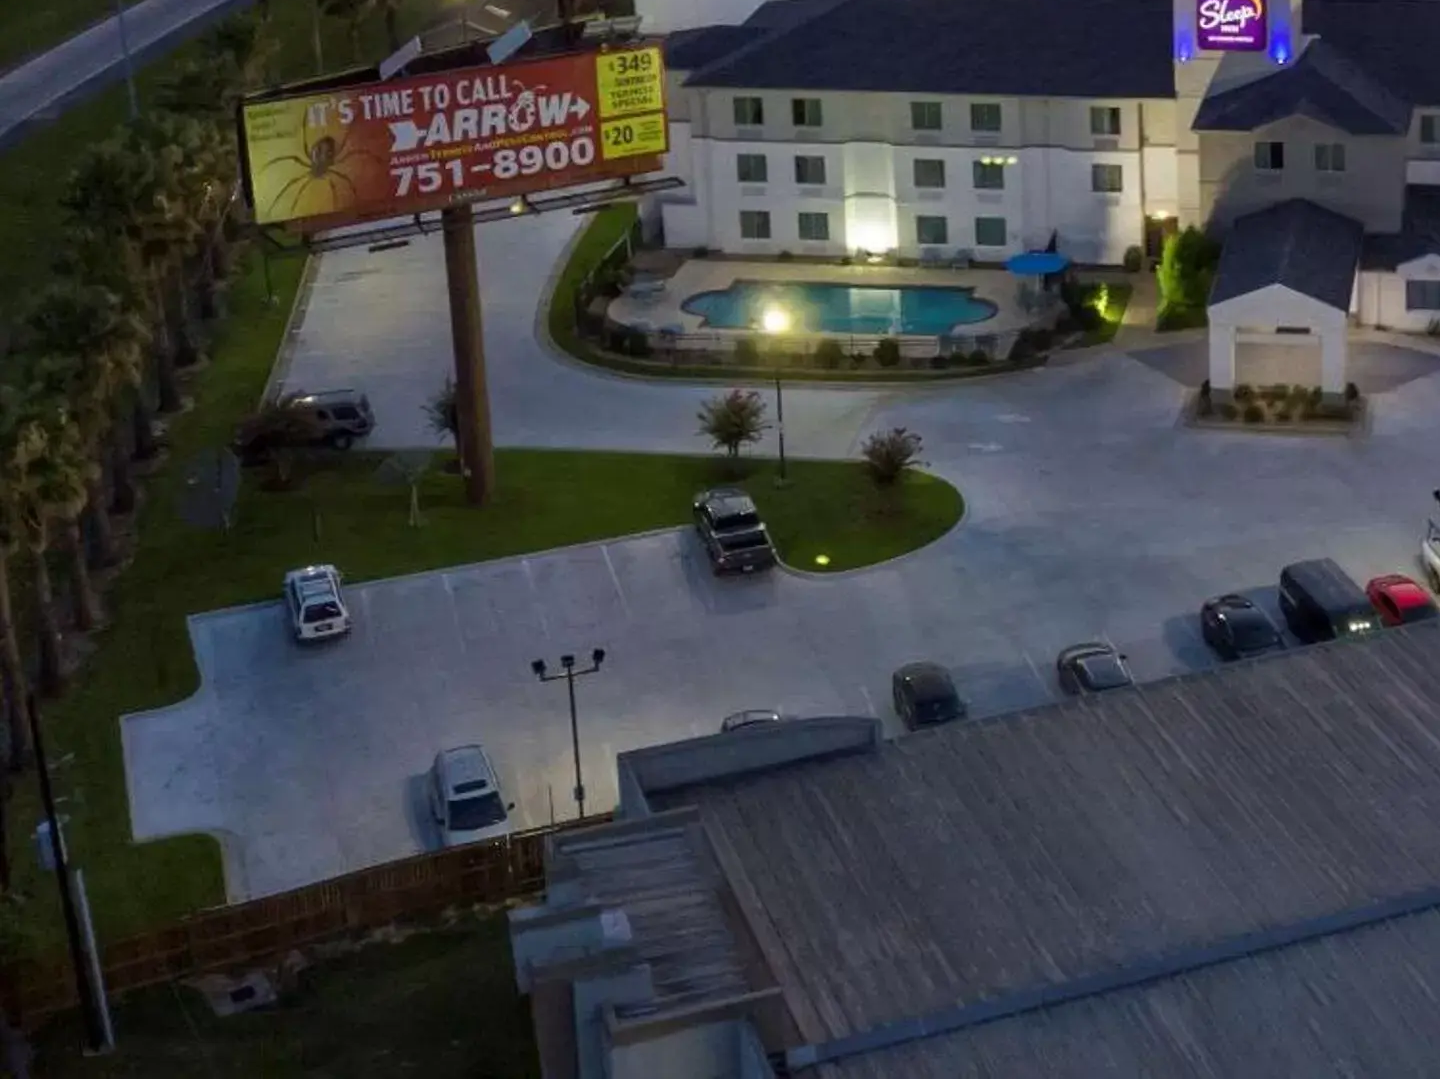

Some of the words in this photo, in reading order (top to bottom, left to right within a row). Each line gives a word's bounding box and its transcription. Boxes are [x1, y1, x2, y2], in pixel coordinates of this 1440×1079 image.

[1199, 0, 1257, 29] Sleep
[308, 96, 354, 128] IT'S
[359, 89, 414, 120] TIME
[419, 84, 450, 110] TO
[457, 75, 512, 103] CALL
[424, 90, 573, 147] ARROW
[604, 125, 633, 146] $20
[390, 137, 594, 197] 751-8900
